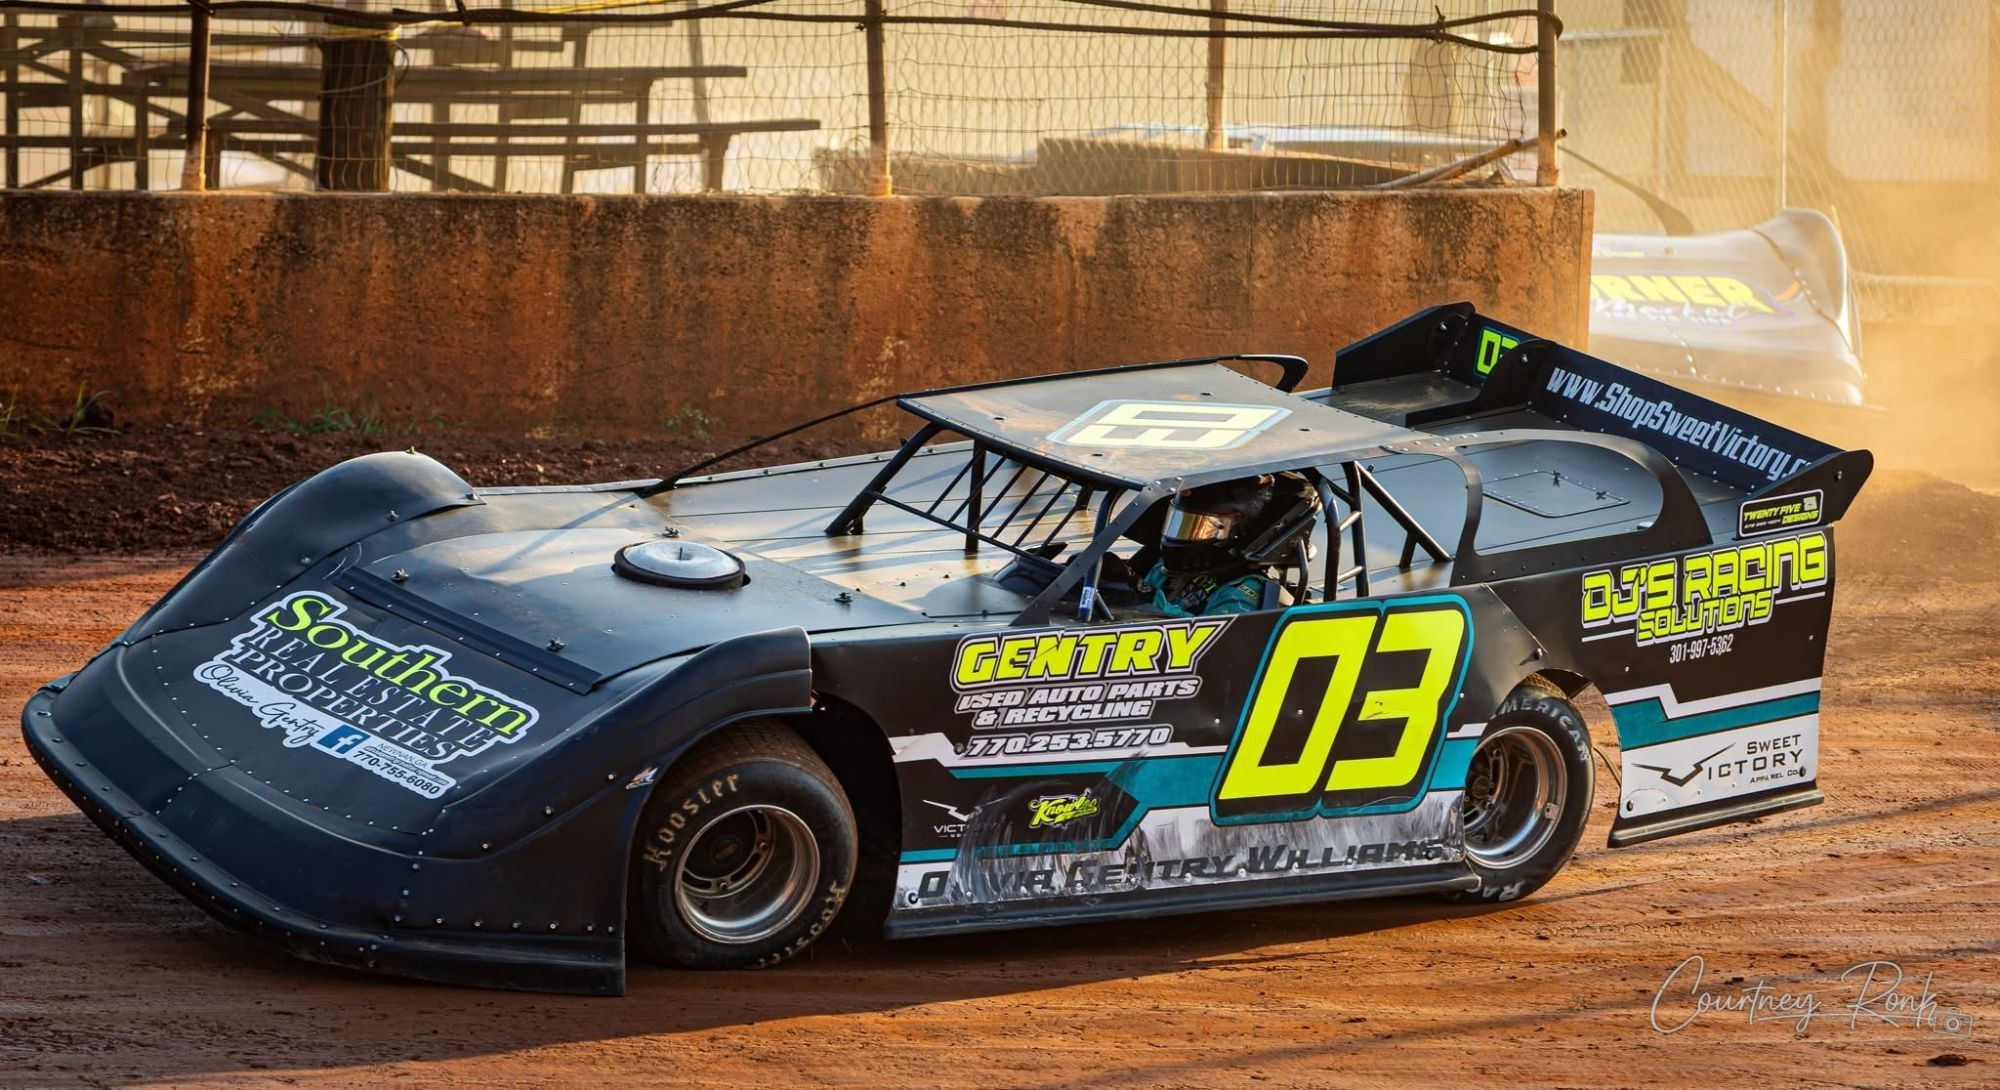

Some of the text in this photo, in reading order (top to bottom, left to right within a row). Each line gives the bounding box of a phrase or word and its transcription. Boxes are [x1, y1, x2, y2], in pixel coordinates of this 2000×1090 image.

[1591, 274, 1775, 313] RNER
[1546, 366, 1812, 481] www.ShopSweetVictory.c
[1743, 503, 1802, 522] TWENTY FIVE
[1781, 509, 1820, 525] DESIGNS
[1583, 534, 1827, 622] DJ'S RACING
[1637, 590, 1775, 642] SOLUTIONS
[265, 597, 528, 736] Southern
[955, 625, 1216, 686] GENTRY
[1669, 633, 1735, 664] 301-997-5362
[200, 663, 327, 744] Olivia Gentry
[231, 648, 456, 761] PROPERTIES
[247, 624, 497, 749] REAL ESTATE
[957, 679, 1200, 710] USED AUTO PARTS
[975, 700, 1153, 727] & RECYCLING
[1217, 608, 1466, 800] 03
[968, 727, 1170, 757] 770.253.5770
[1494, 697, 1591, 763] MERICAN
[352, 750, 441, 795] 770-755-6080
